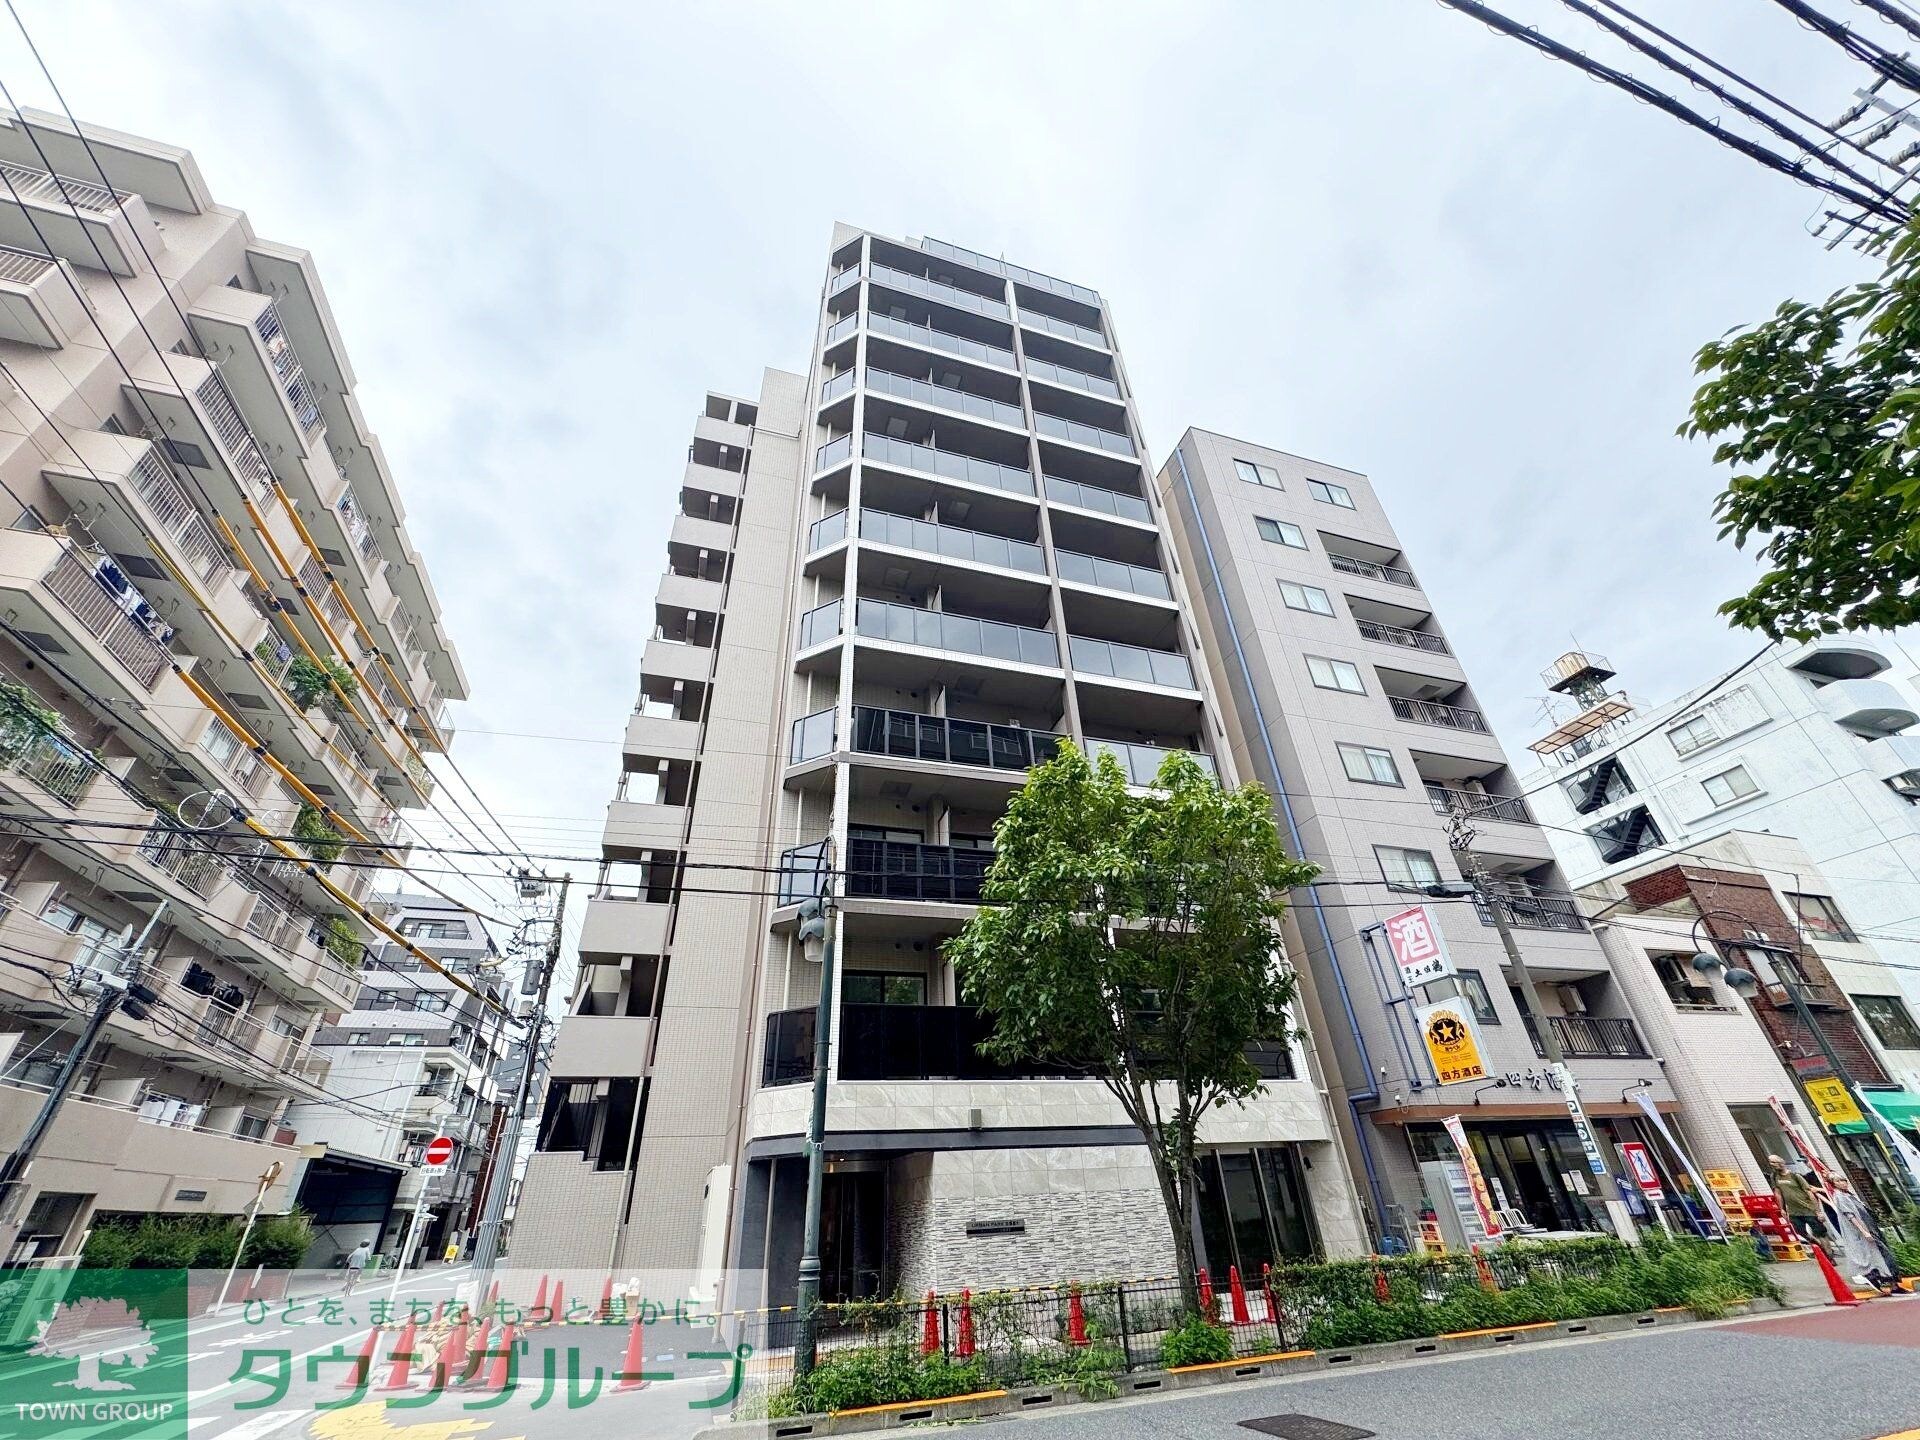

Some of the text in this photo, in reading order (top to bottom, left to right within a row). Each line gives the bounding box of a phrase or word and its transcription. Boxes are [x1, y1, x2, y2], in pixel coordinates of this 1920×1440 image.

[1391, 913, 1434, 961] 酒
[1441, 1065, 1482, 1080] 四方酒店
